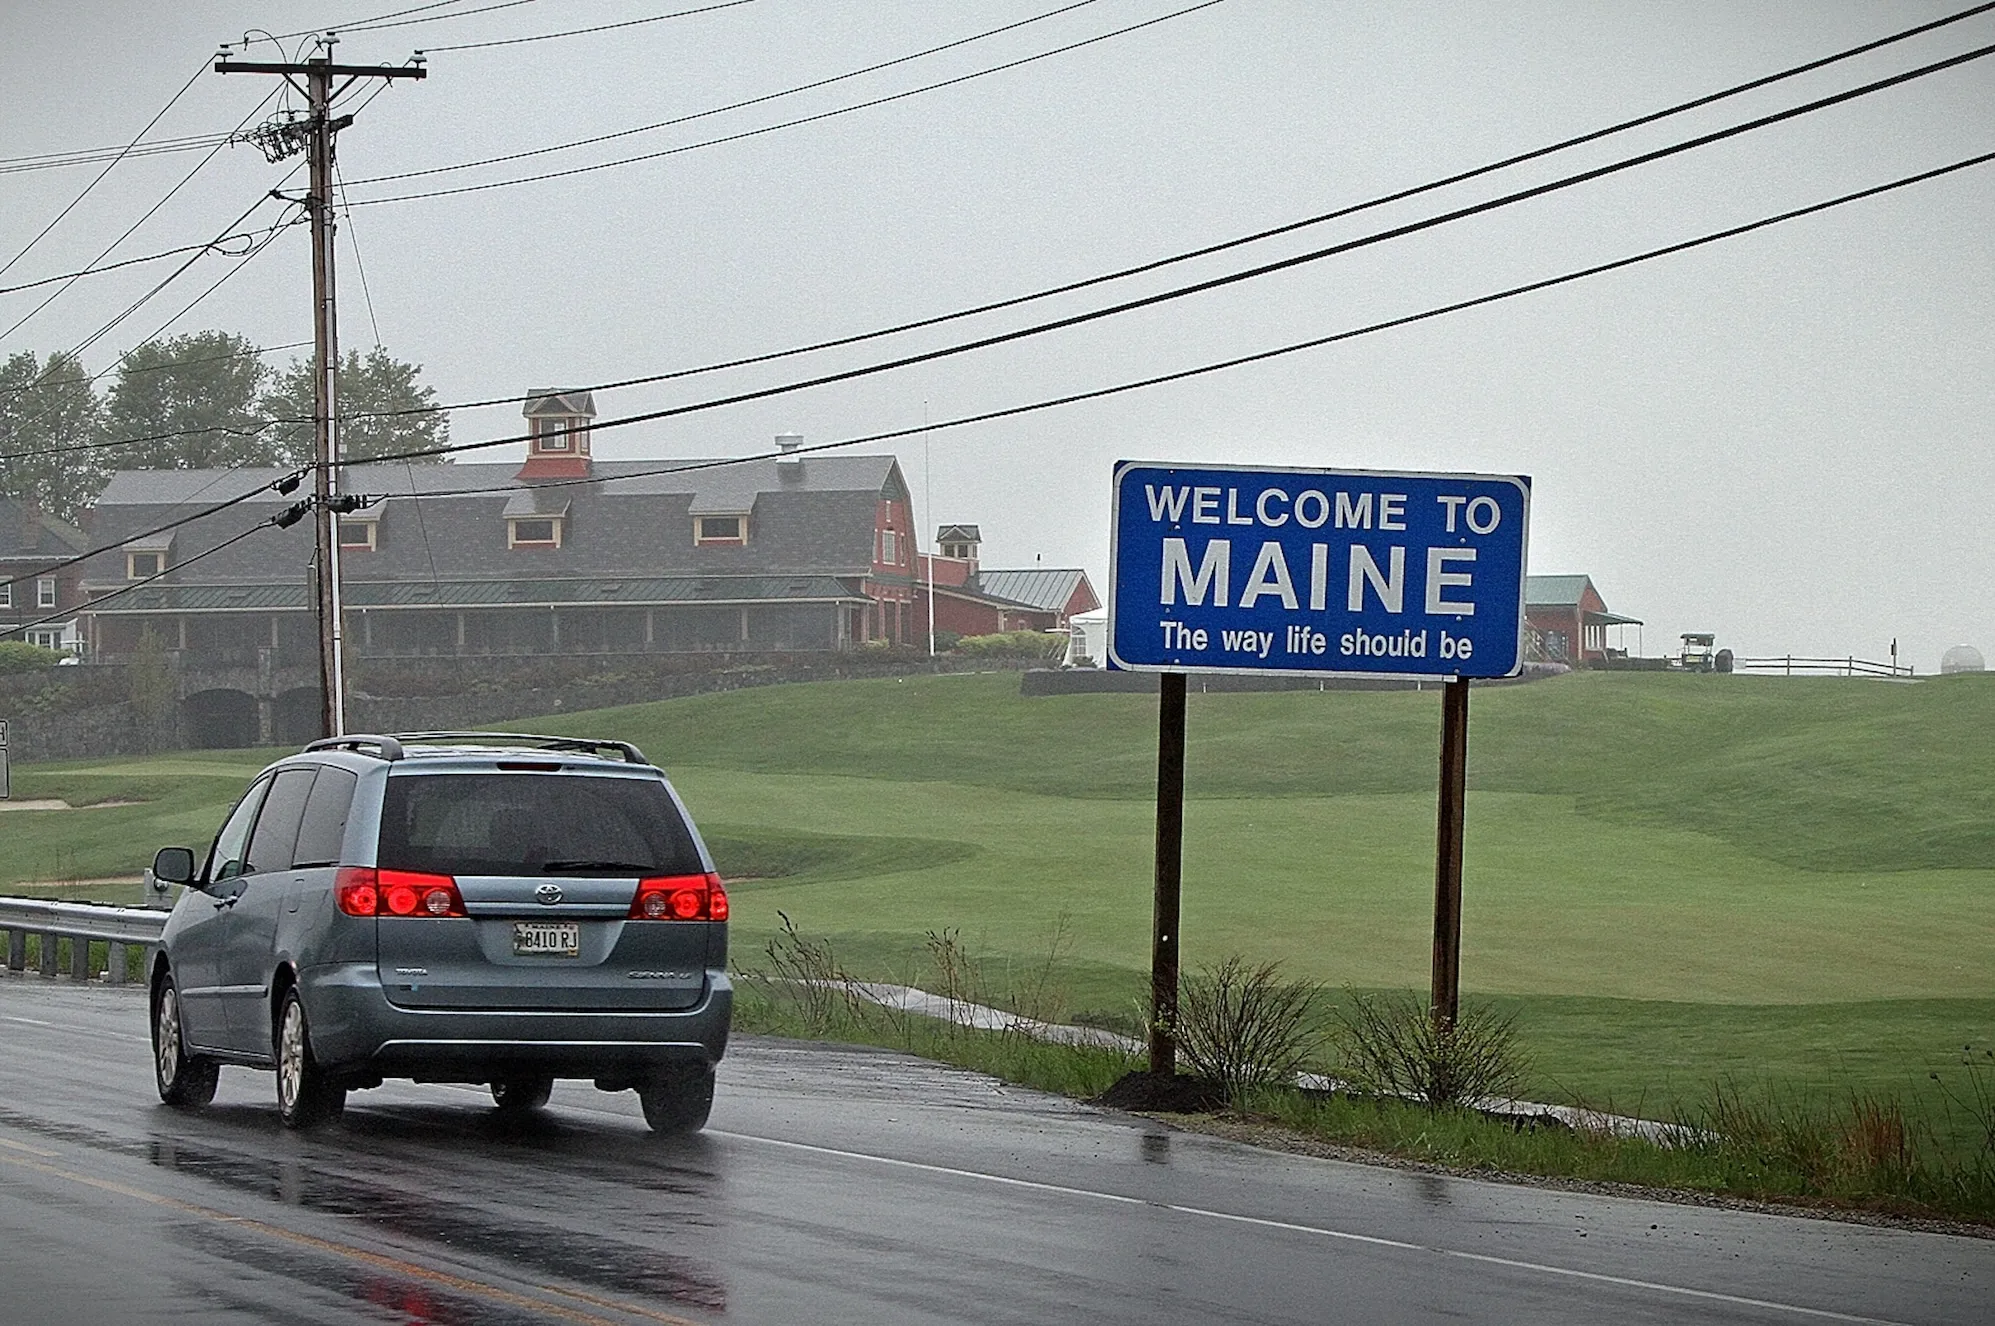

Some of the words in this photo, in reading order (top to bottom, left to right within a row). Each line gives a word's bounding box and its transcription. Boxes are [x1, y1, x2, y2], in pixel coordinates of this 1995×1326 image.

[1144, 484, 1408, 531] WELCOME
[1437, 495, 1501, 535] TO
[1160, 537, 1478, 616] MAINE
[1160, 620, 1209, 651] The
[1222, 629, 1274, 659] way
[1286, 625, 1327, 656] life
[1340, 629, 1428, 659] should
[1439, 630, 1474, 660] be
[525, 931, 557, 948] 8410
[561, 931, 577, 948] RJ
